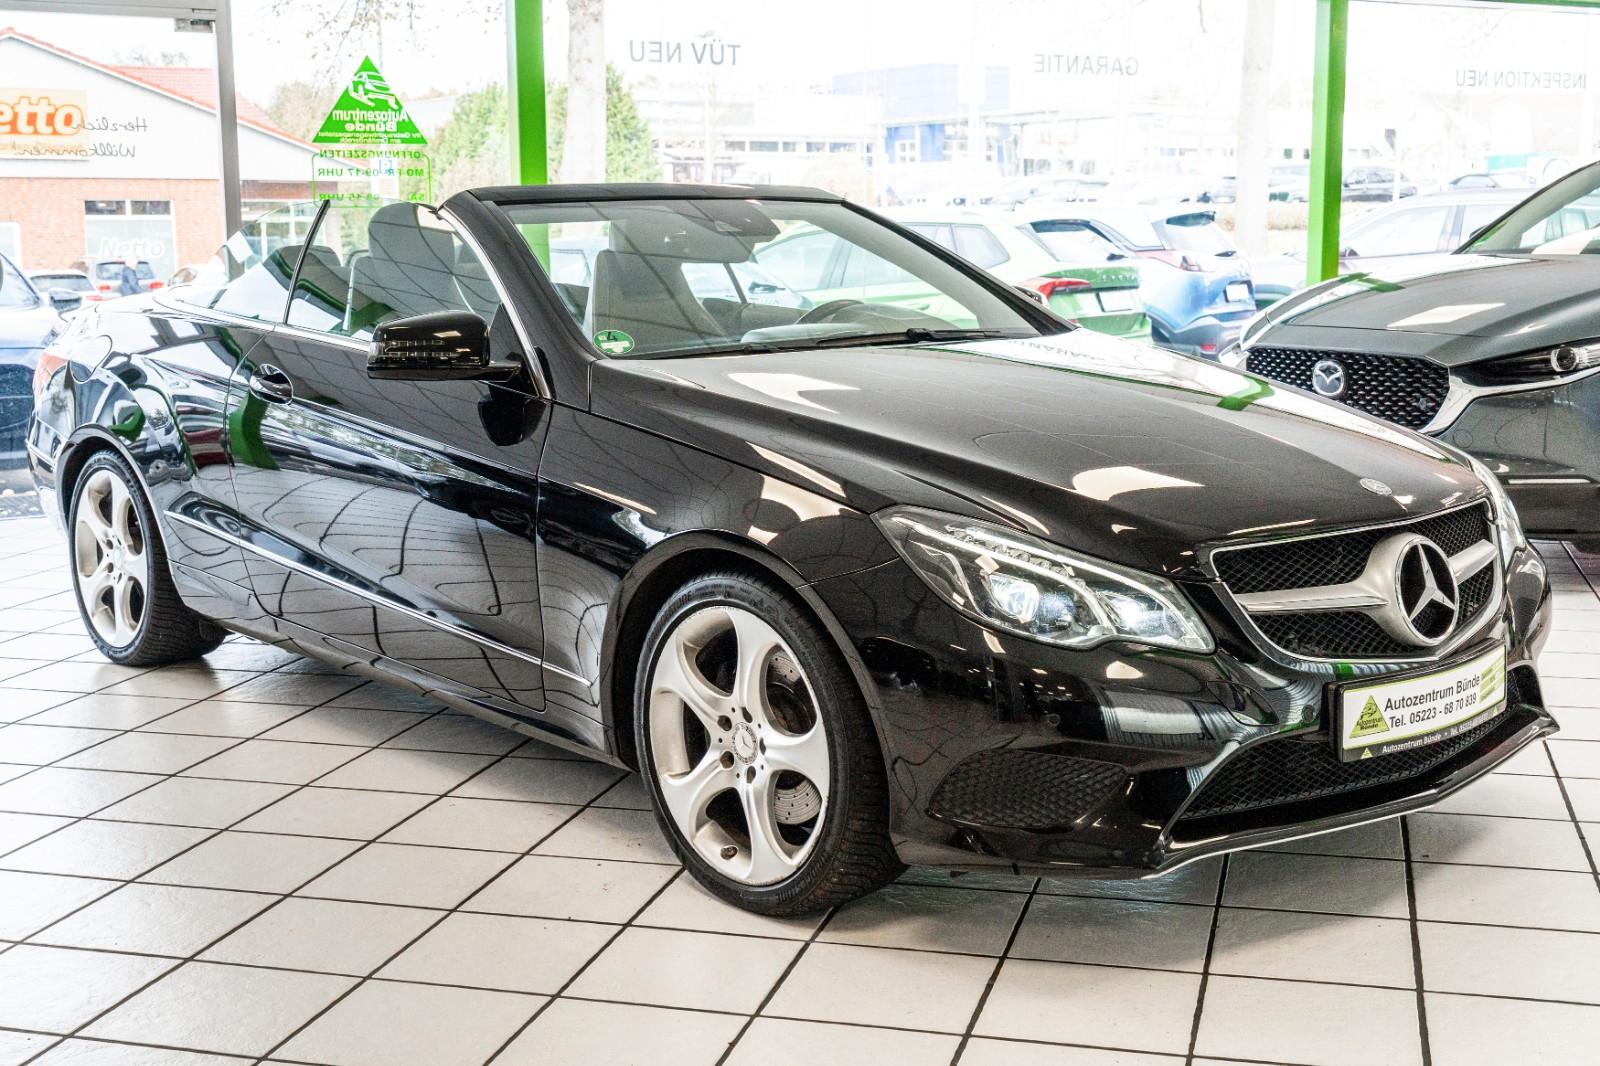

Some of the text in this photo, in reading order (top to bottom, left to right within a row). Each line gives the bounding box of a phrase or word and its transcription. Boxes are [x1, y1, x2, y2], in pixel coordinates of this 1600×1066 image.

[99, 237, 165, 258] Netto
[1384, 685, 1453, 712] Autozentrum
[1456, 673, 1480, 694] Bünde
[1389, 714, 1407, 728] Tel.
[1409, 706, 1437, 724] 05223
[1443, 701, 1454, 715] 68
[1455, 697, 1464, 711] 70
[1465, 692, 1477, 707] 839
[1382, 737, 1423, 754] Autozentrum
[1424, 732, 1442, 746] Bünde
